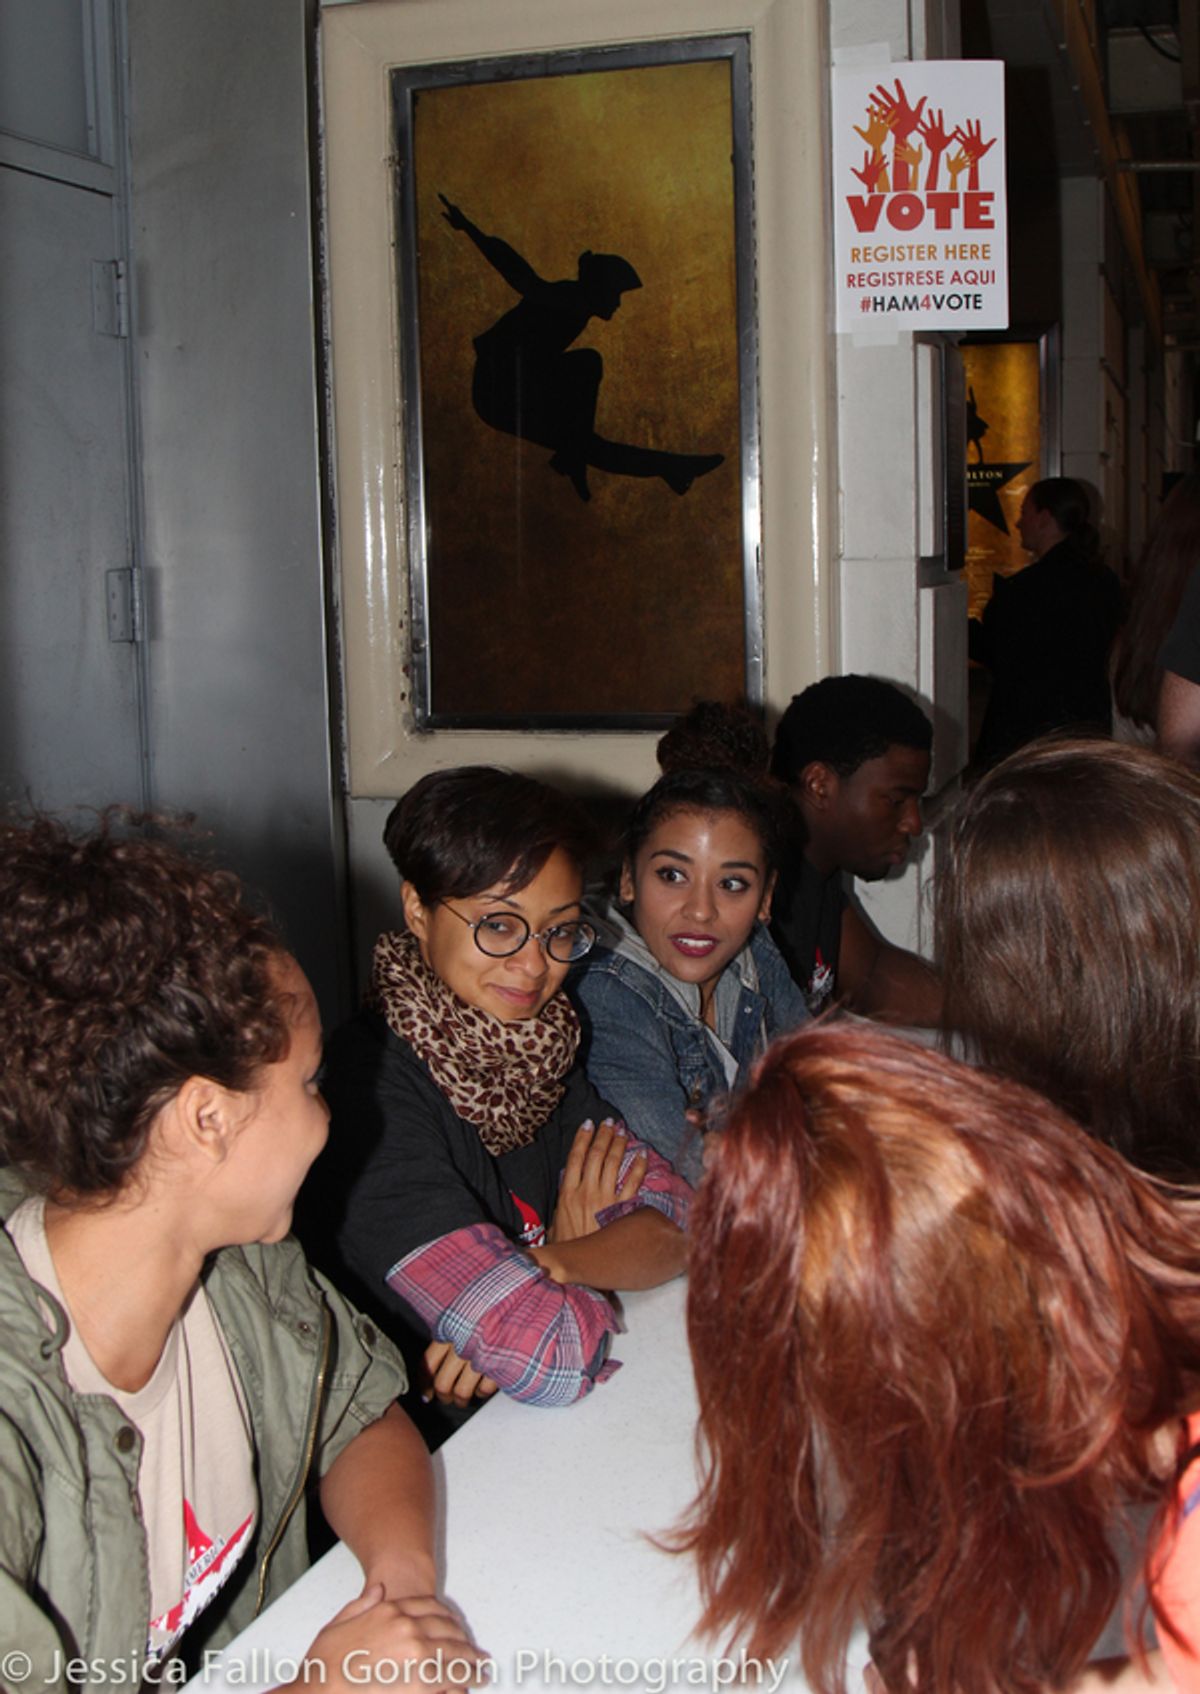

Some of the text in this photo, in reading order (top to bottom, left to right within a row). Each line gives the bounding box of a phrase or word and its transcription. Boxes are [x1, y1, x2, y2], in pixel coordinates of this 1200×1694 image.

[846, 192, 995, 232] VOTE
[851, 244, 991, 263] REGISTER HERE
[847, 270, 996, 288] REGISTRESE AQUI
[860, 293, 983, 312] #HAM4VOTE
